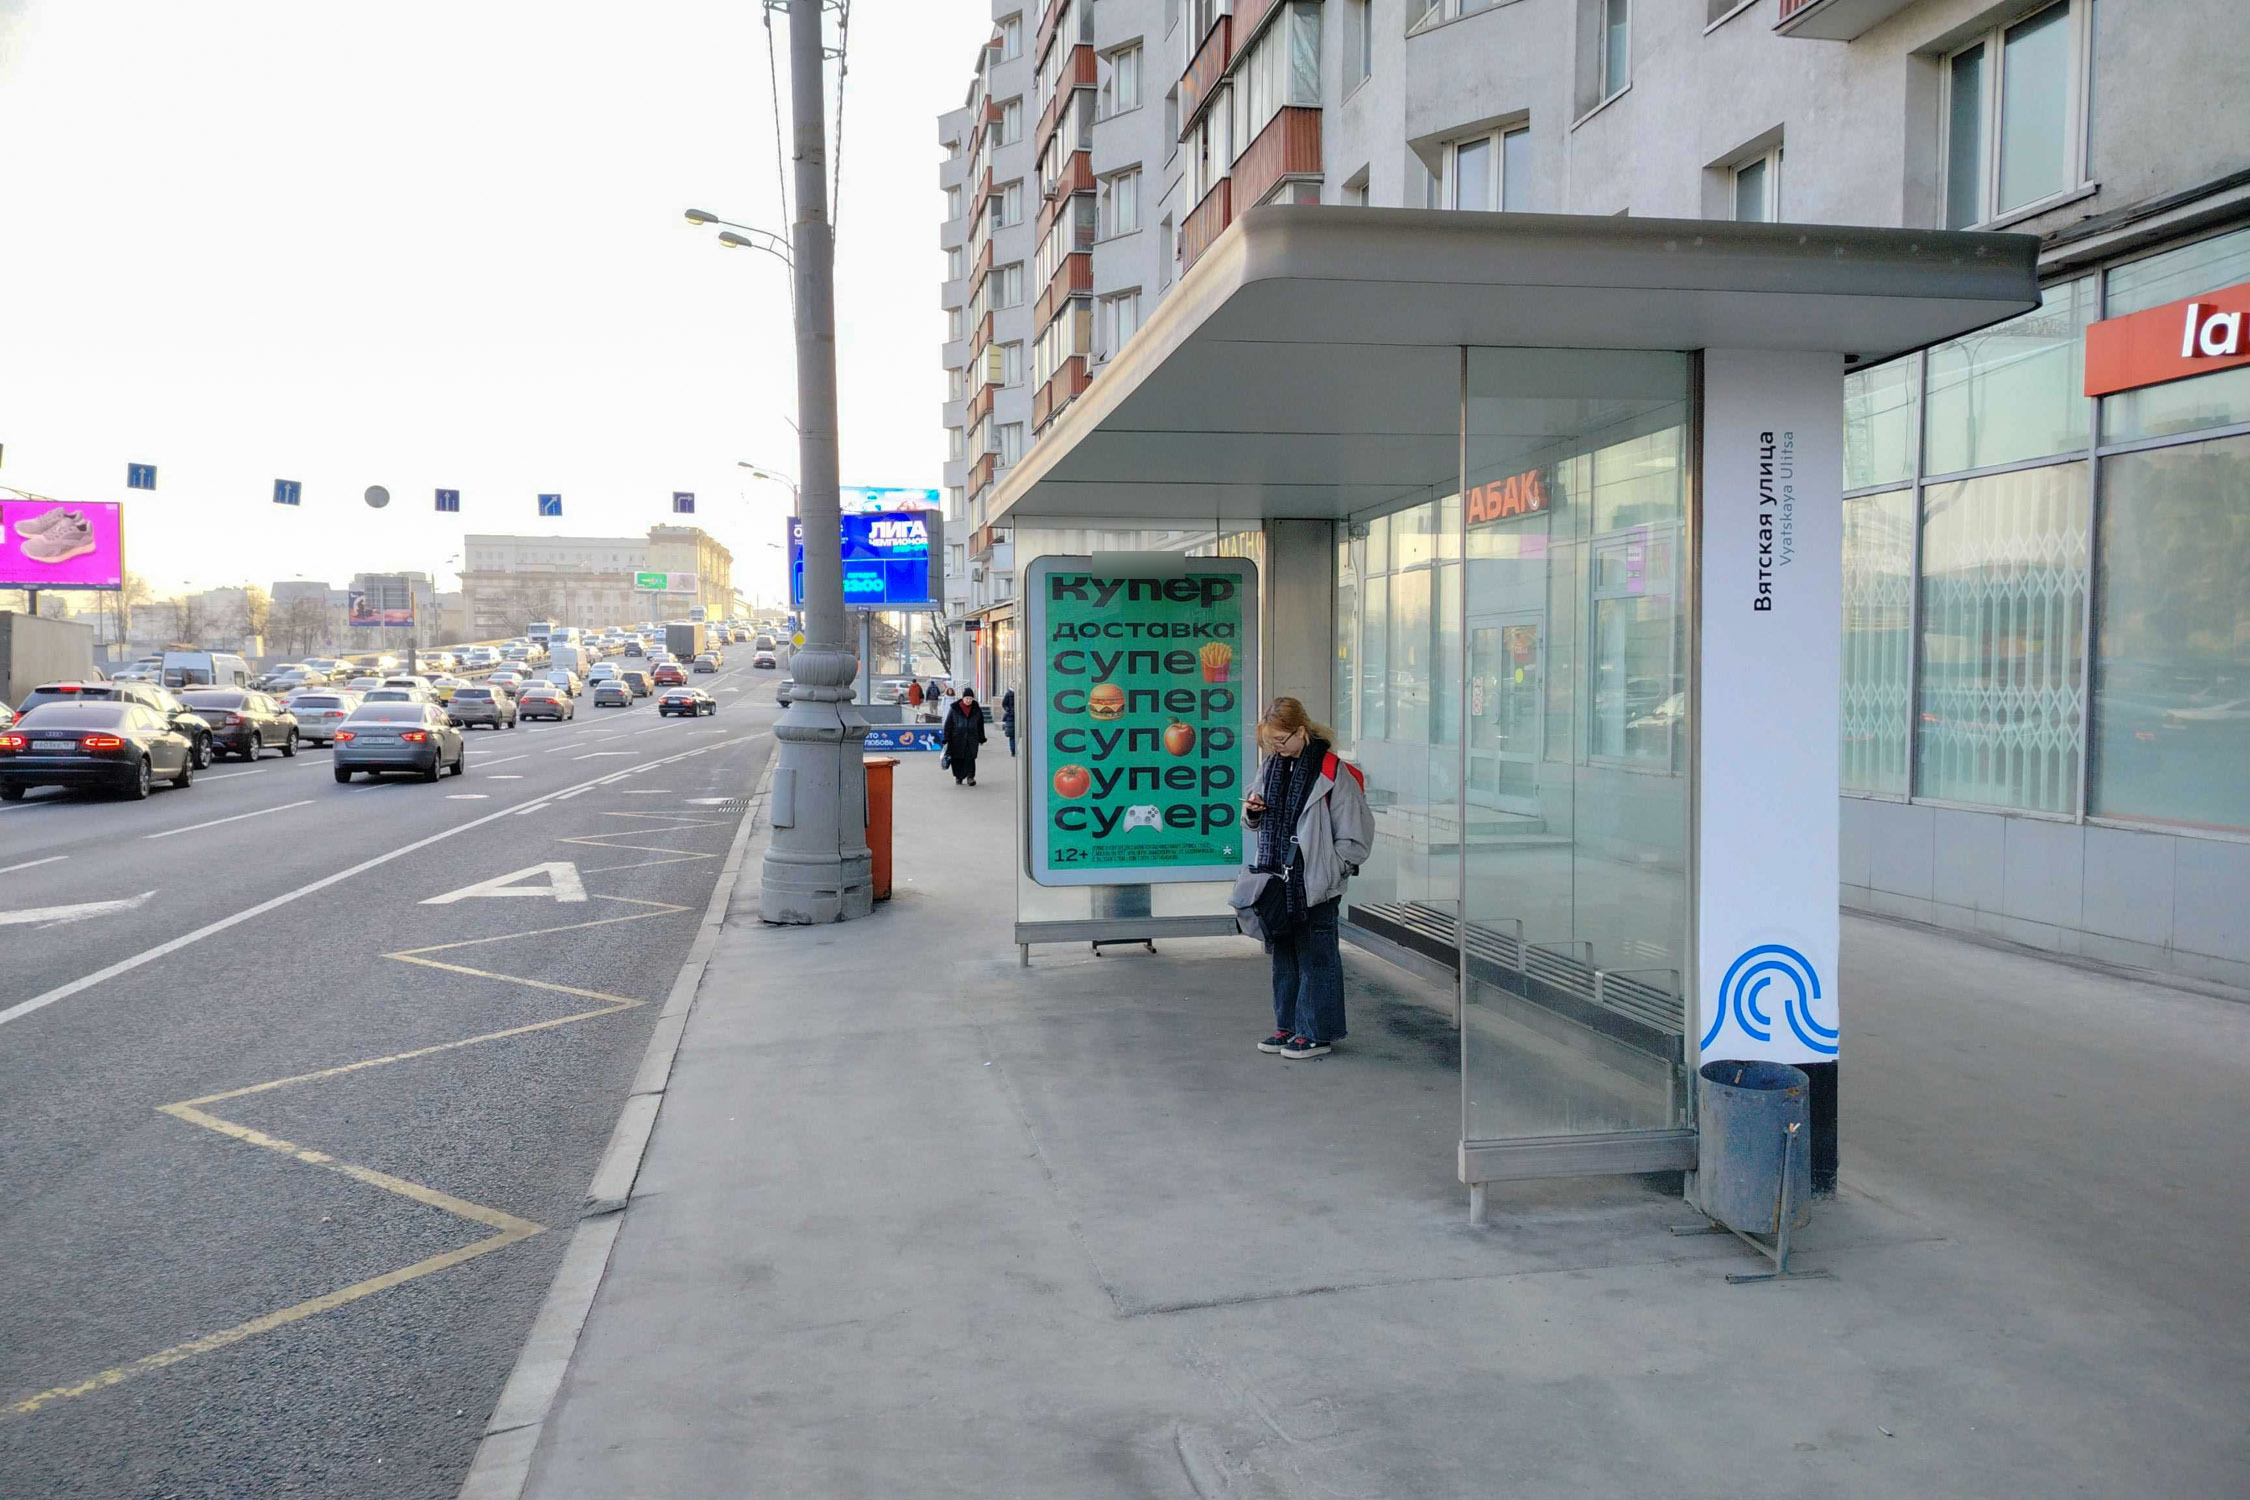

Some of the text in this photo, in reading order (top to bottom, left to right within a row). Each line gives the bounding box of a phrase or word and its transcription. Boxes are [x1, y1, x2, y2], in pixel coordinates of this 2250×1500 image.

[2181, 303, 2250, 358] la
[1466, 469, 1540, 524] АБАК
[1779, 431, 1795, 567] Vyatskaya Ulitsa
[868, 520, 928, 539] ЛИГА
[1754, 431, 1777, 611] Вятская улица
[1052, 577, 1234, 608] купер
[1053, 622, 1235, 642] доставка
[1053, 650, 1232, 683] супе
[1053, 684, 1234, 721] спер
[1054, 727, 1235, 760] супр
[1054, 765, 1235, 799] упер
[1054, 803, 1235, 839] суер
[1054, 848, 1089, 862] 12+
